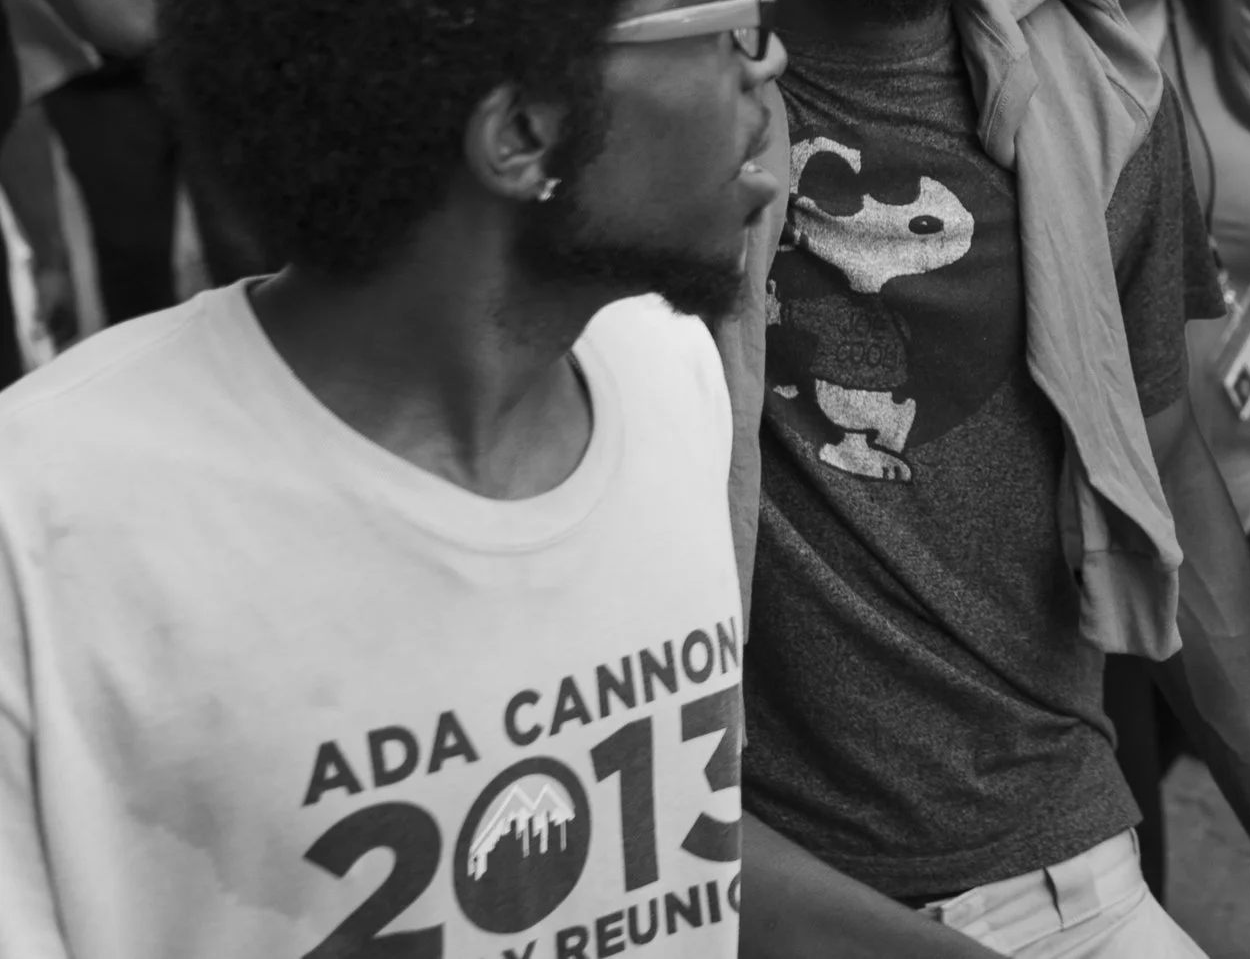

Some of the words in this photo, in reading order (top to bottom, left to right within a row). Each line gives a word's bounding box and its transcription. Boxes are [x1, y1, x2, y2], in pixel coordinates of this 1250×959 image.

[300, 683, 741, 959] 2013
[302, 709, 480, 807] ADA
[504, 615, 739, 746] CANNON
